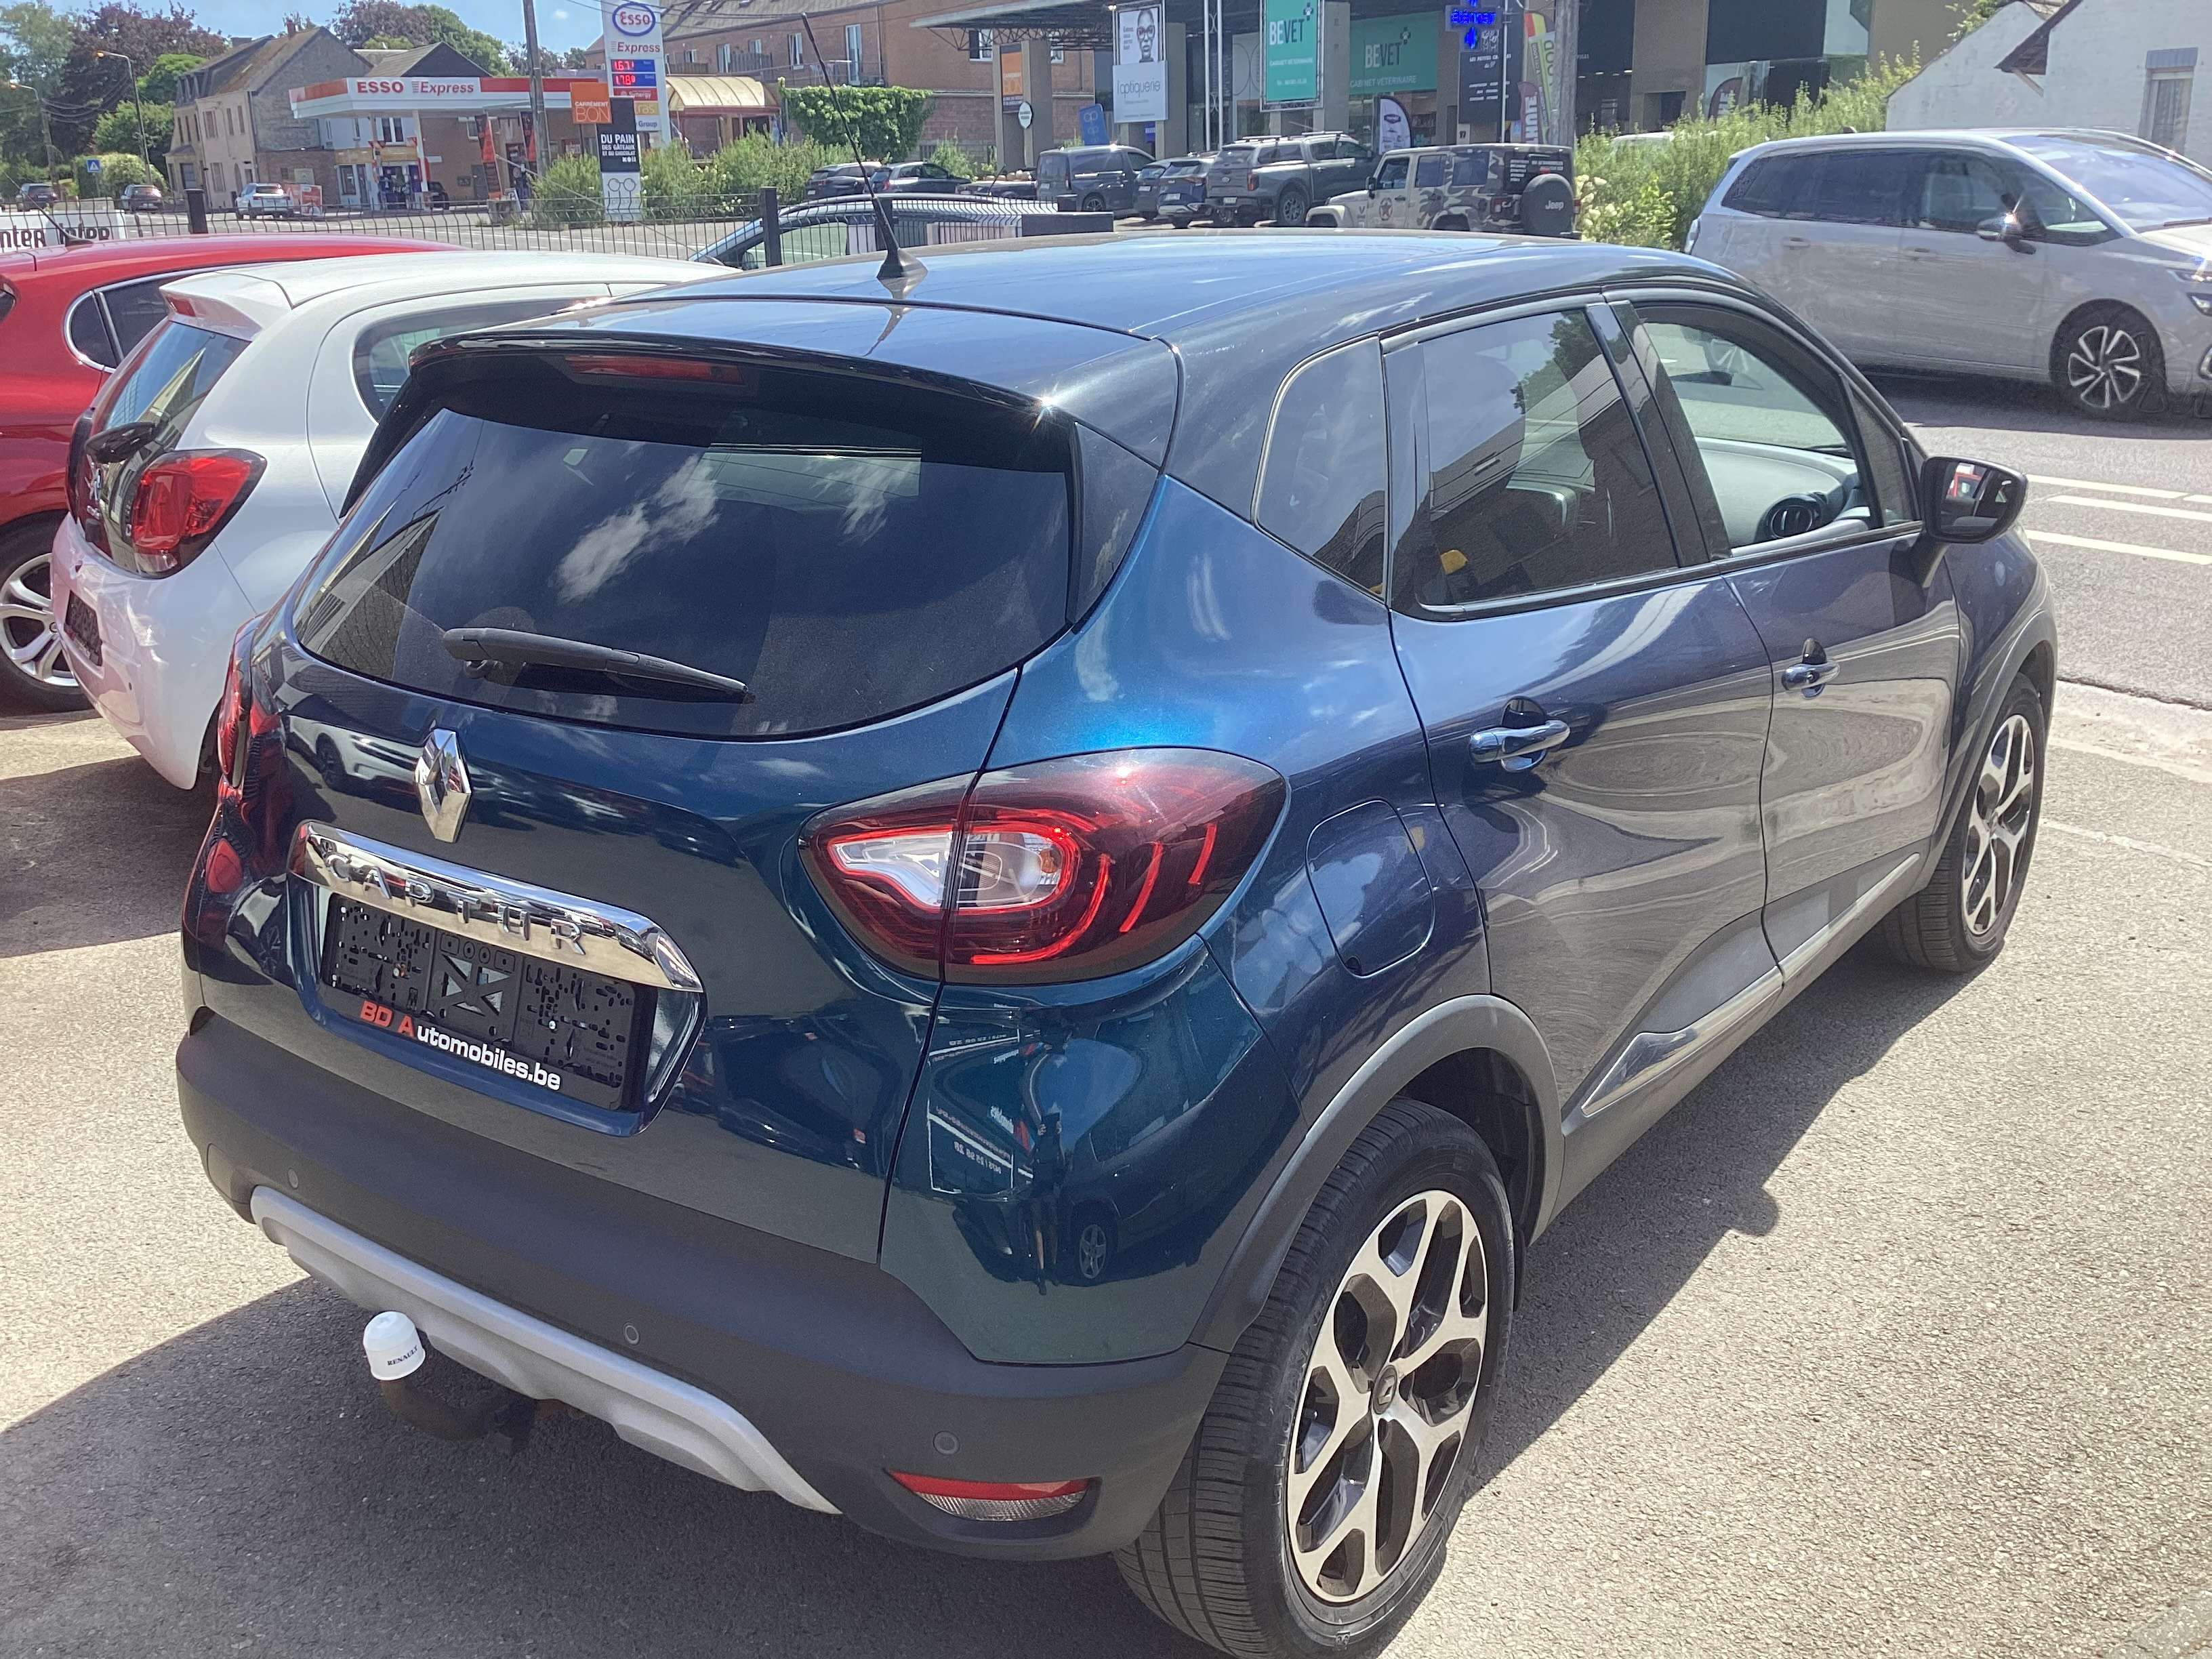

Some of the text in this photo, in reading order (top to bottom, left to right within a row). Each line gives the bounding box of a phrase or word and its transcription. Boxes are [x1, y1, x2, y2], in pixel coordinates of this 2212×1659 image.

[619, 11, 651, 25] Esso
[1269, 18, 1305, 45] BEVET
[617, 41, 661, 54] Express
[1365, 41, 1402, 68] BEVET
[356, 81, 474, 96] ESSO Express
[575, 107, 611, 123] BON
[600, 134, 635, 144] DU PAIN
[1545, 200, 1564, 211] Jeep
[326, 853, 586, 956] CAPTUR
[360, 1000, 394, 1027] BD
[387, 1345, 418, 1366] RENAULT
